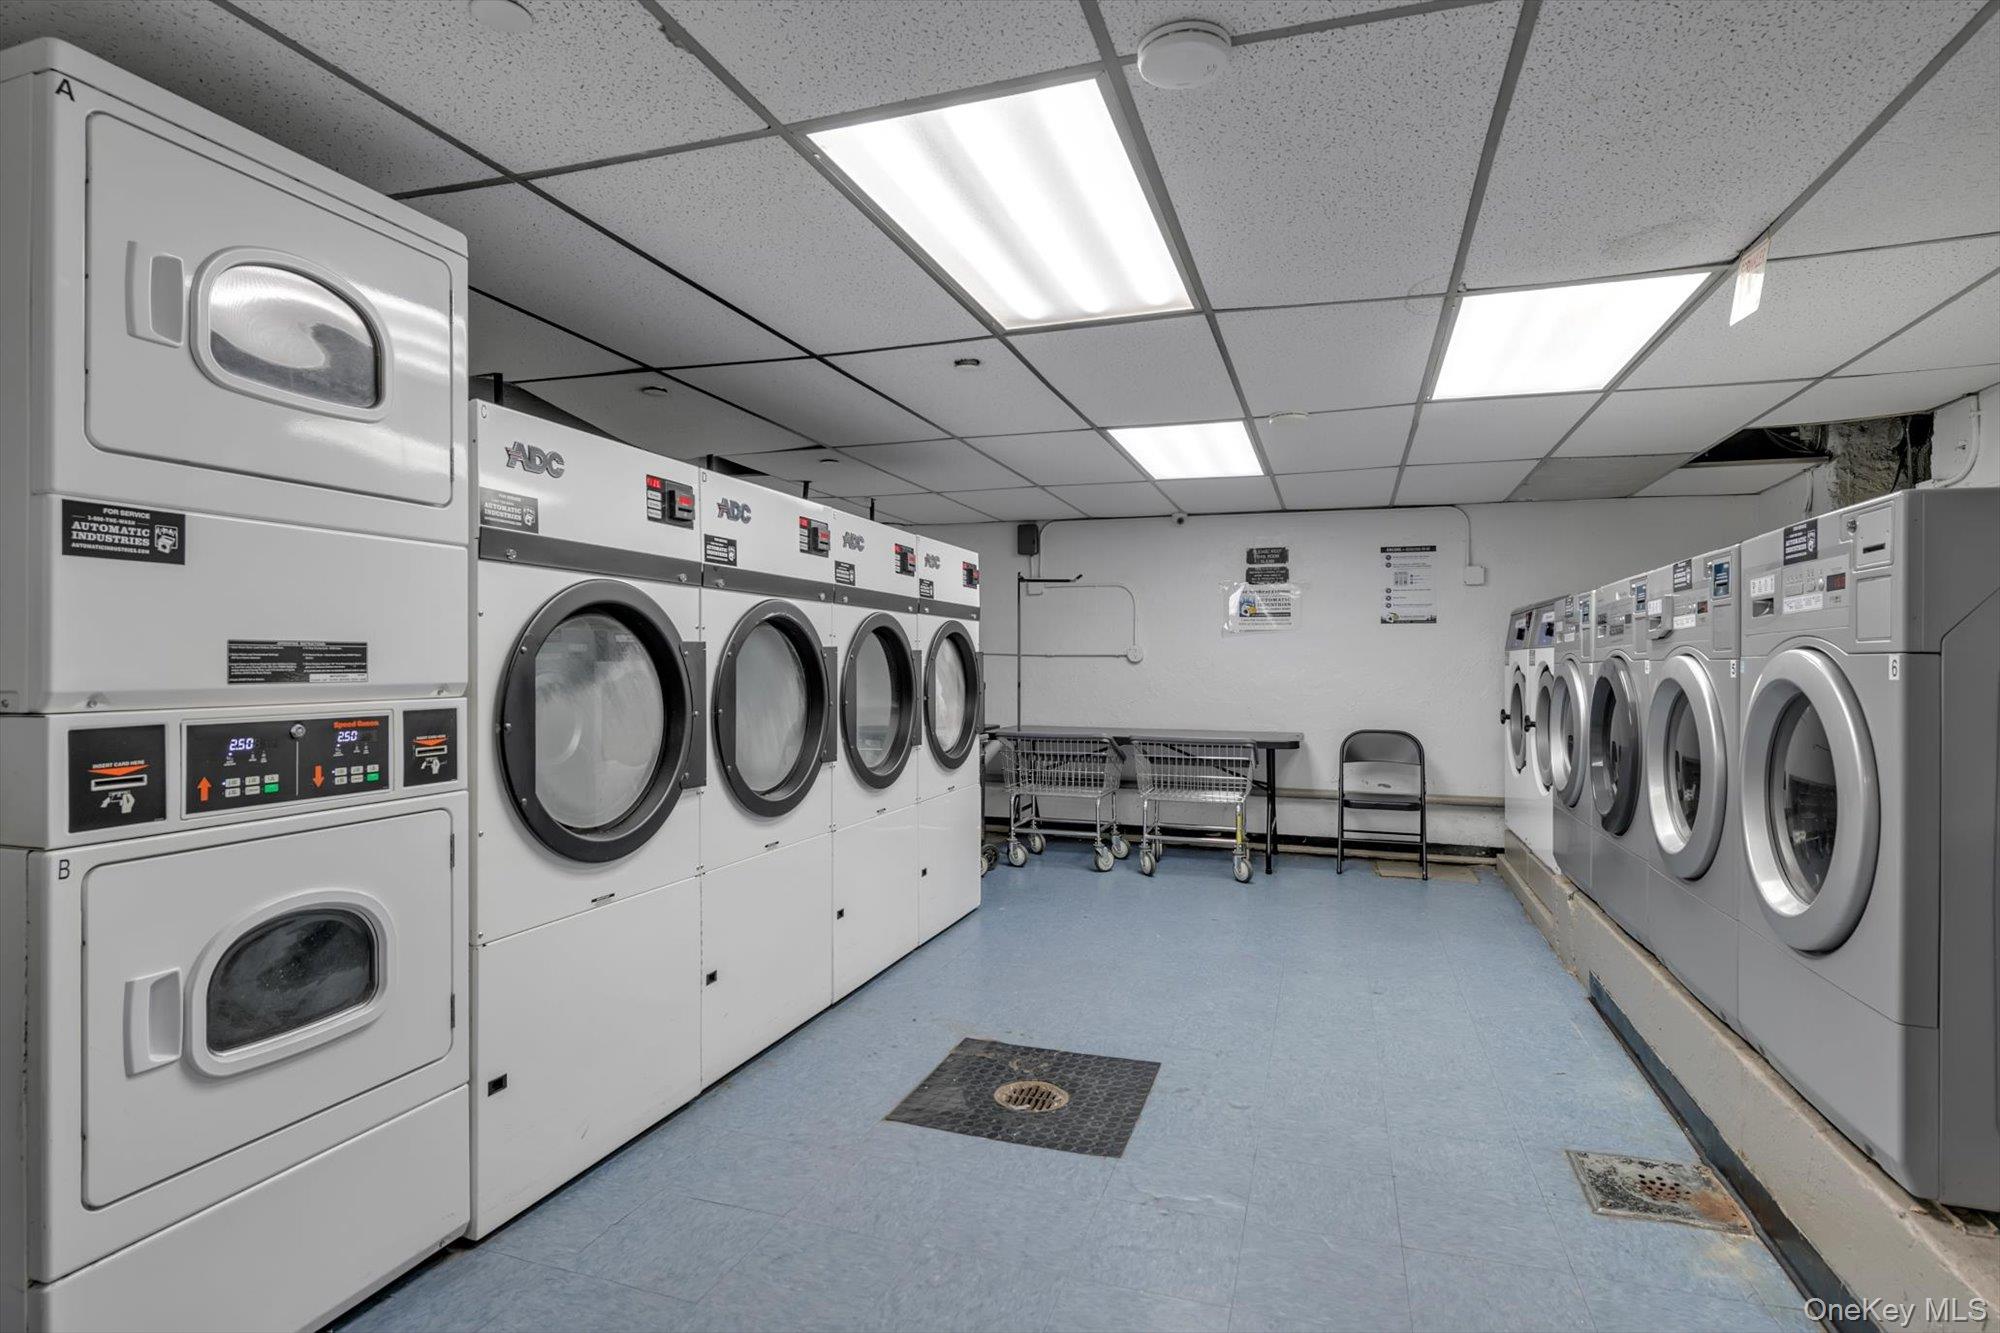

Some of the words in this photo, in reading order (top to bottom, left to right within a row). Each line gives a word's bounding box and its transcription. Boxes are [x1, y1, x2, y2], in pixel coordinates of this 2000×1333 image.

[55, 78, 75, 102] A
[480, 404, 488, 419] C
[505, 441, 565, 479] ADC
[120, 509, 150, 519] SERVICE
[716, 497, 752, 524] ADC
[71, 520, 150, 537] AUTOMATIC
[71, 530, 150, 547] INDUSTRIES
[1891, 659, 1898, 677] 6
[58, 859, 70, 880] B
